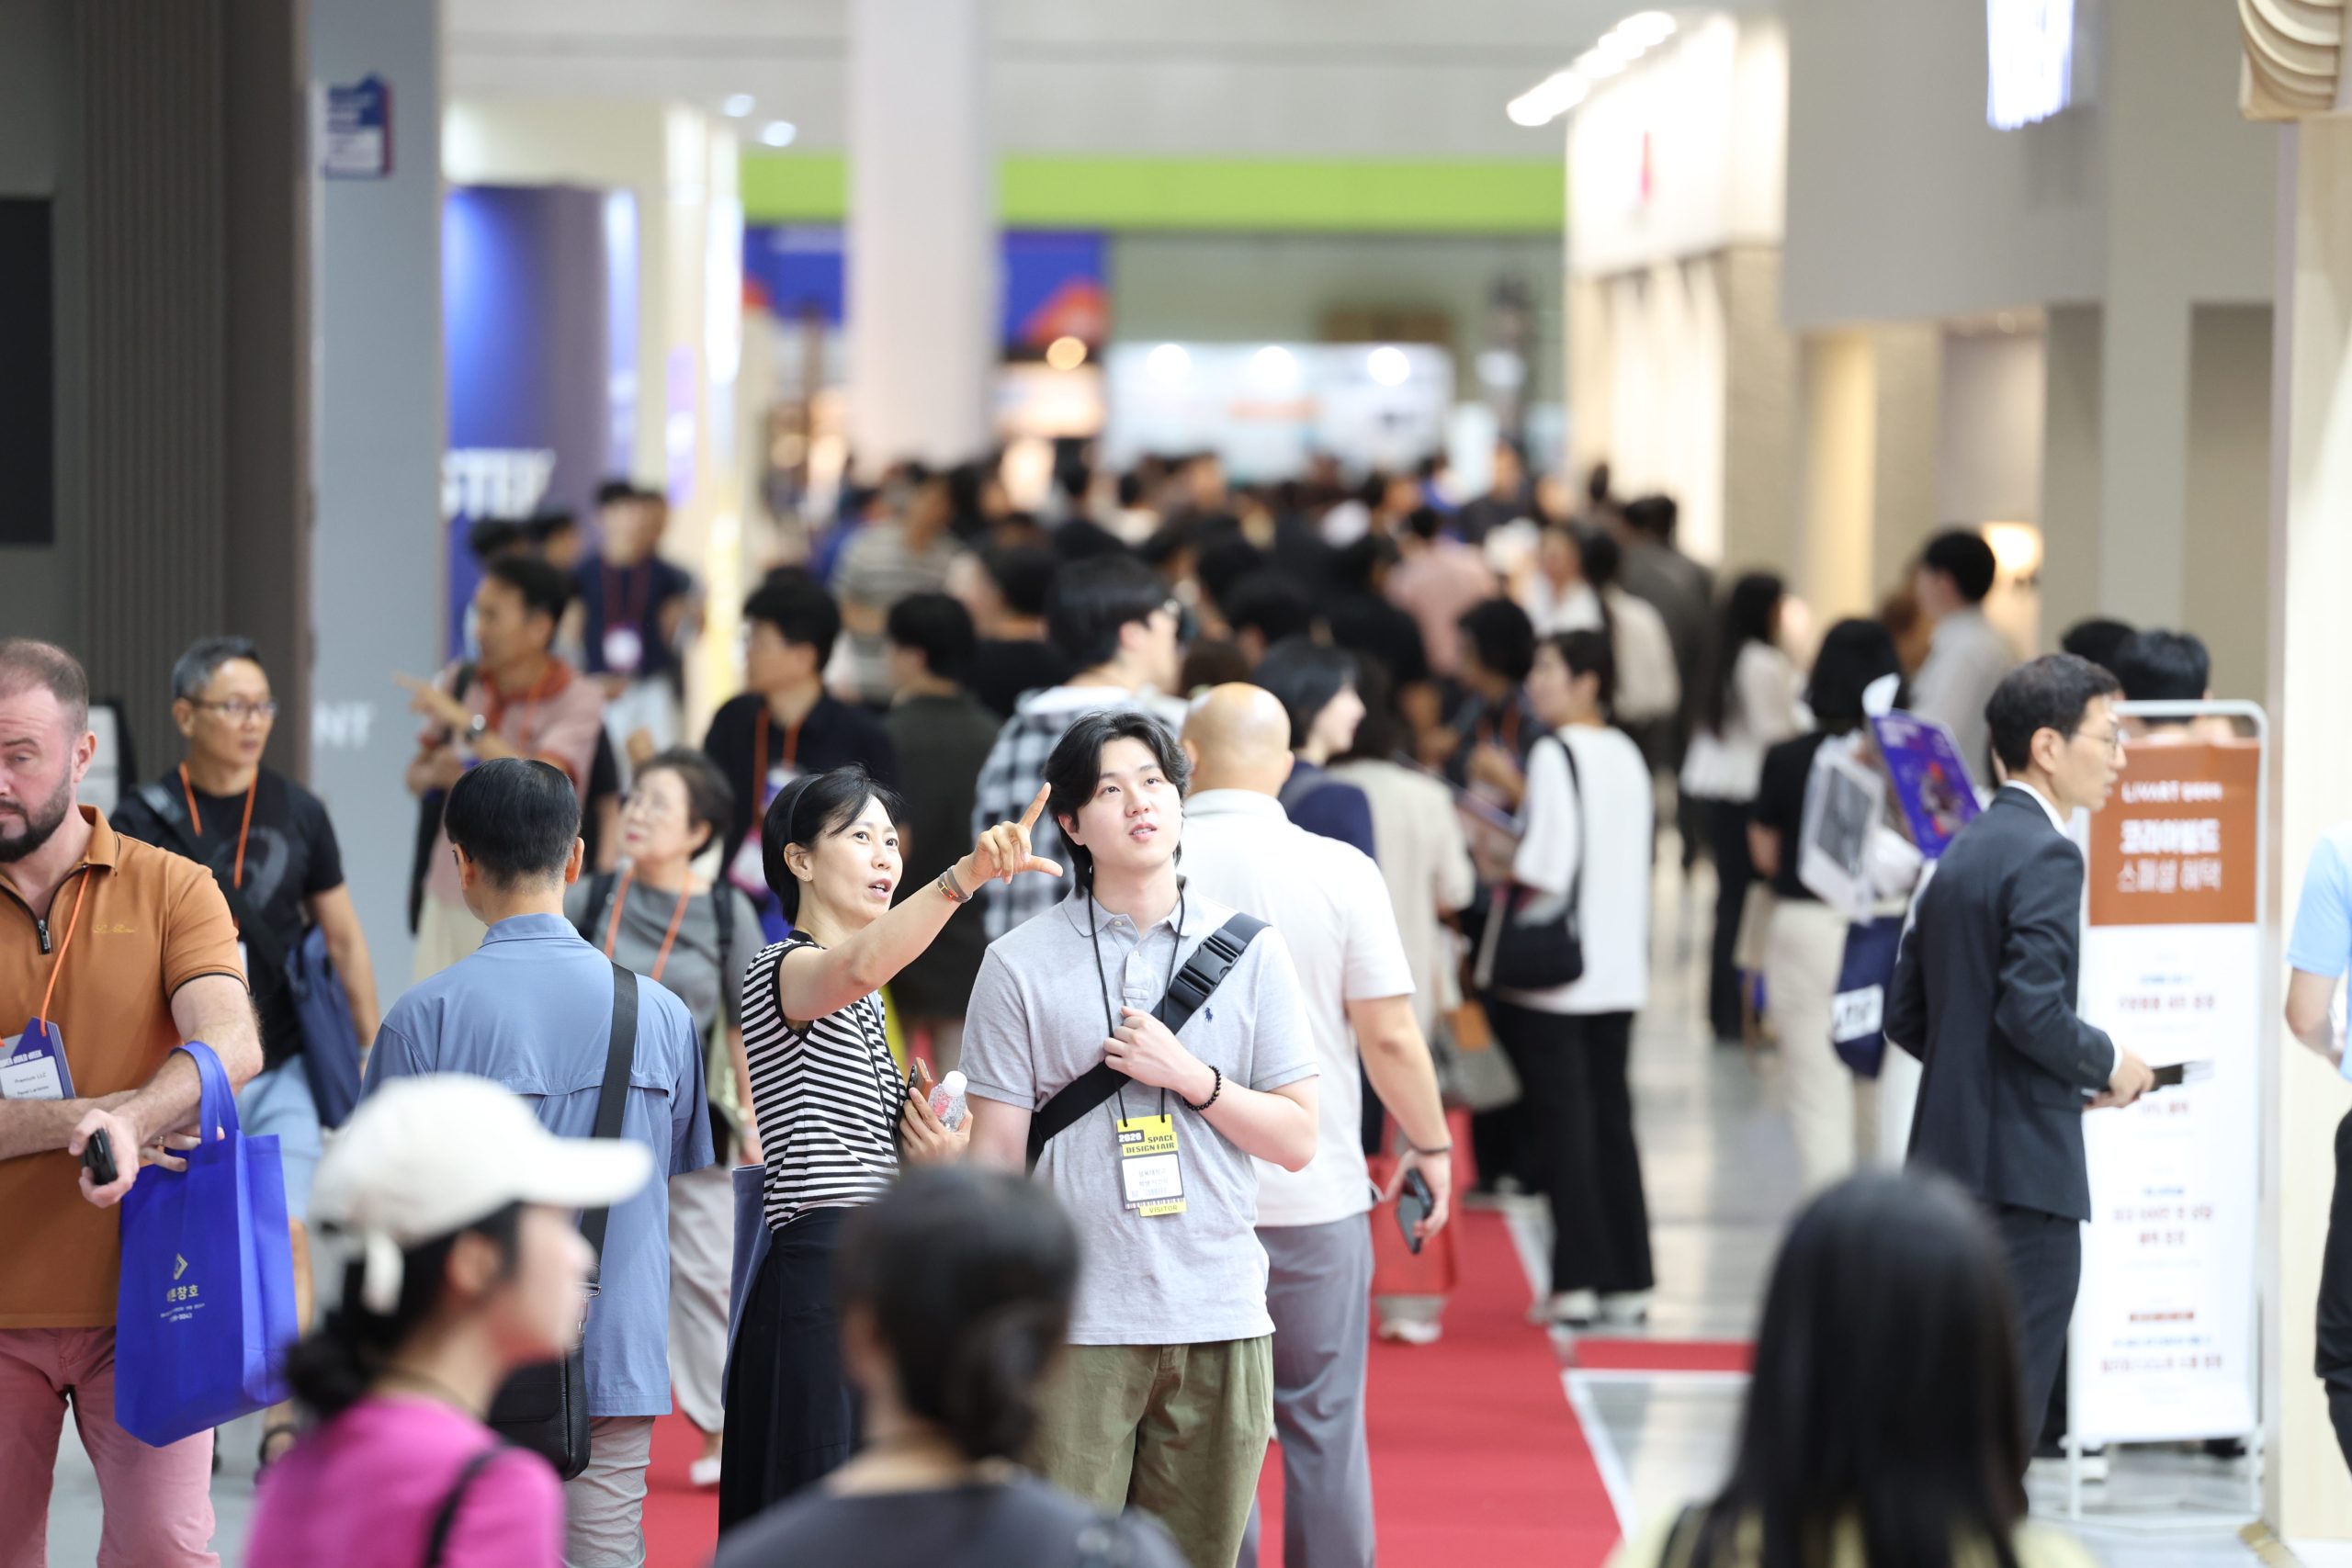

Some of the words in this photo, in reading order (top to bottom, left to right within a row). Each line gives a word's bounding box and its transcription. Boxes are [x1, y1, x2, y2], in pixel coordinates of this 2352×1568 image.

[1148, 1134, 1173, 1143] SPACE
[1126, 1145, 1156, 1154] DESIGN
[1157, 1142, 1174, 1150] FAIR
[1149, 1205, 1178, 1213] VISITOR
